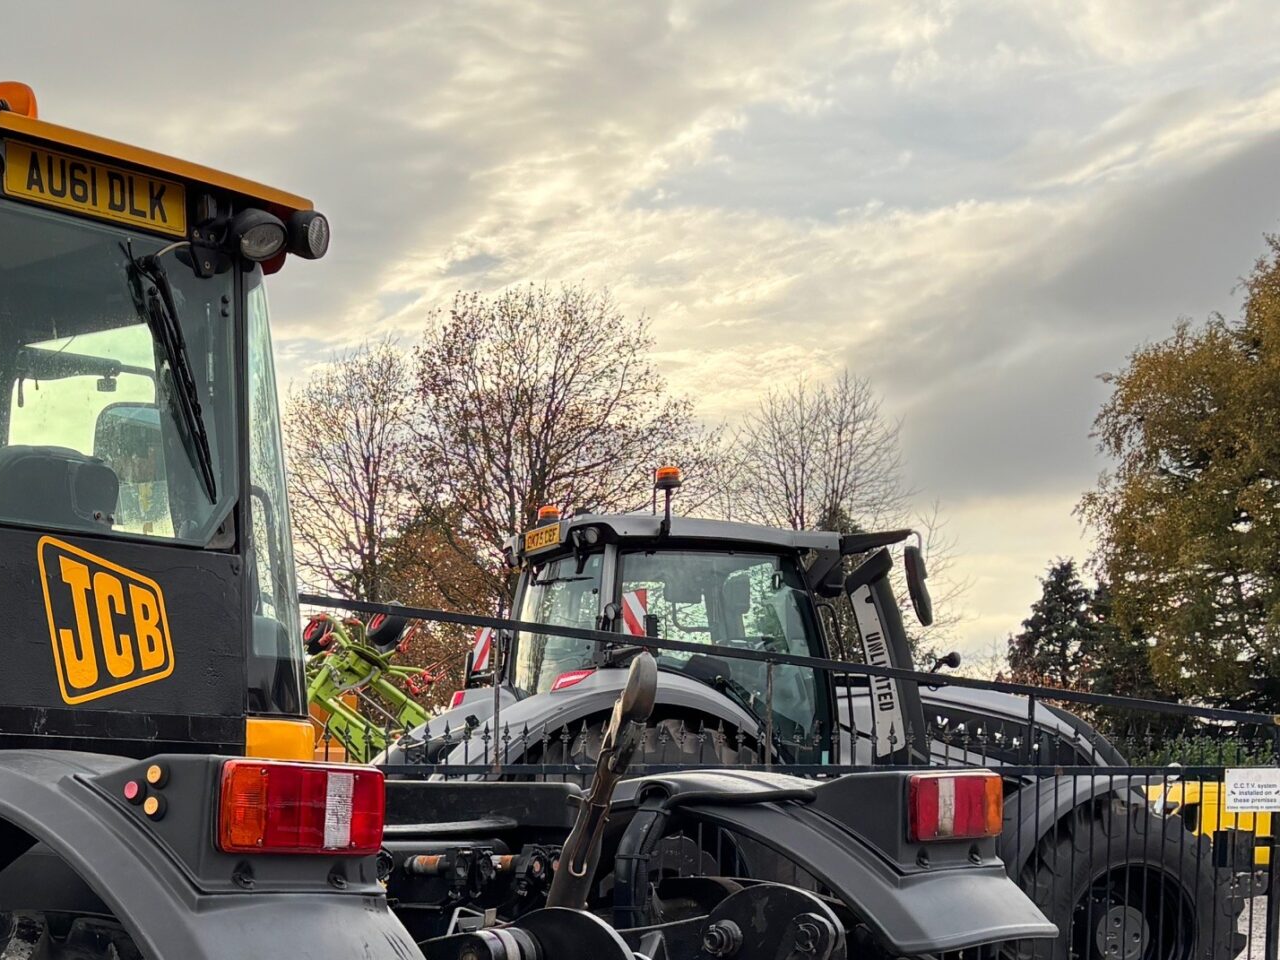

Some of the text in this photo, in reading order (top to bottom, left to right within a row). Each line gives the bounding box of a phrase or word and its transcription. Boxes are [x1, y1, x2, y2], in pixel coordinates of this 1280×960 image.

[26, 151, 168, 224] AU61 DLK
[58, 554, 166, 689] JCB
[865, 631, 895, 712] UNLIITED
